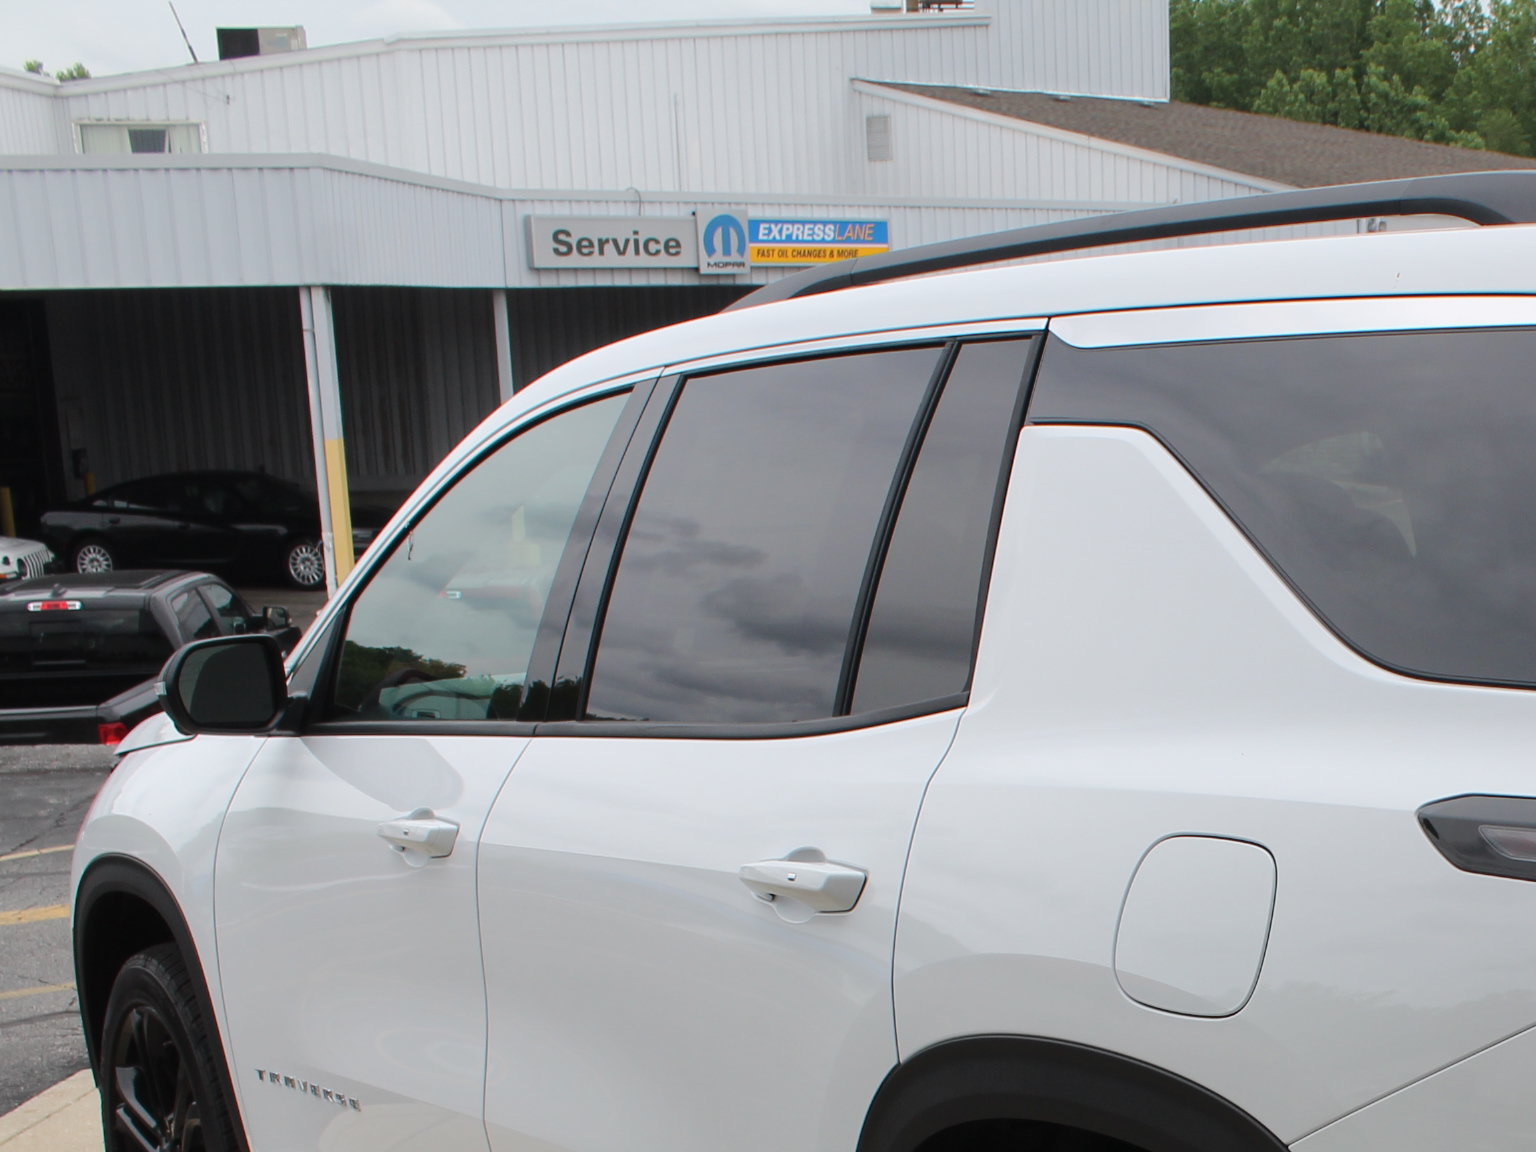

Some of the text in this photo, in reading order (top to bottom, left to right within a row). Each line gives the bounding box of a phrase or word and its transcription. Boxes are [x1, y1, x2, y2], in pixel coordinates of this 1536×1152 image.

[552, 229, 682, 257] Service
[756, 249, 859, 259] FAST OIL CHANGES & MORE
[707, 260, 746, 269] MOPAR
[255, 1068, 362, 1113] TRAVERSE
